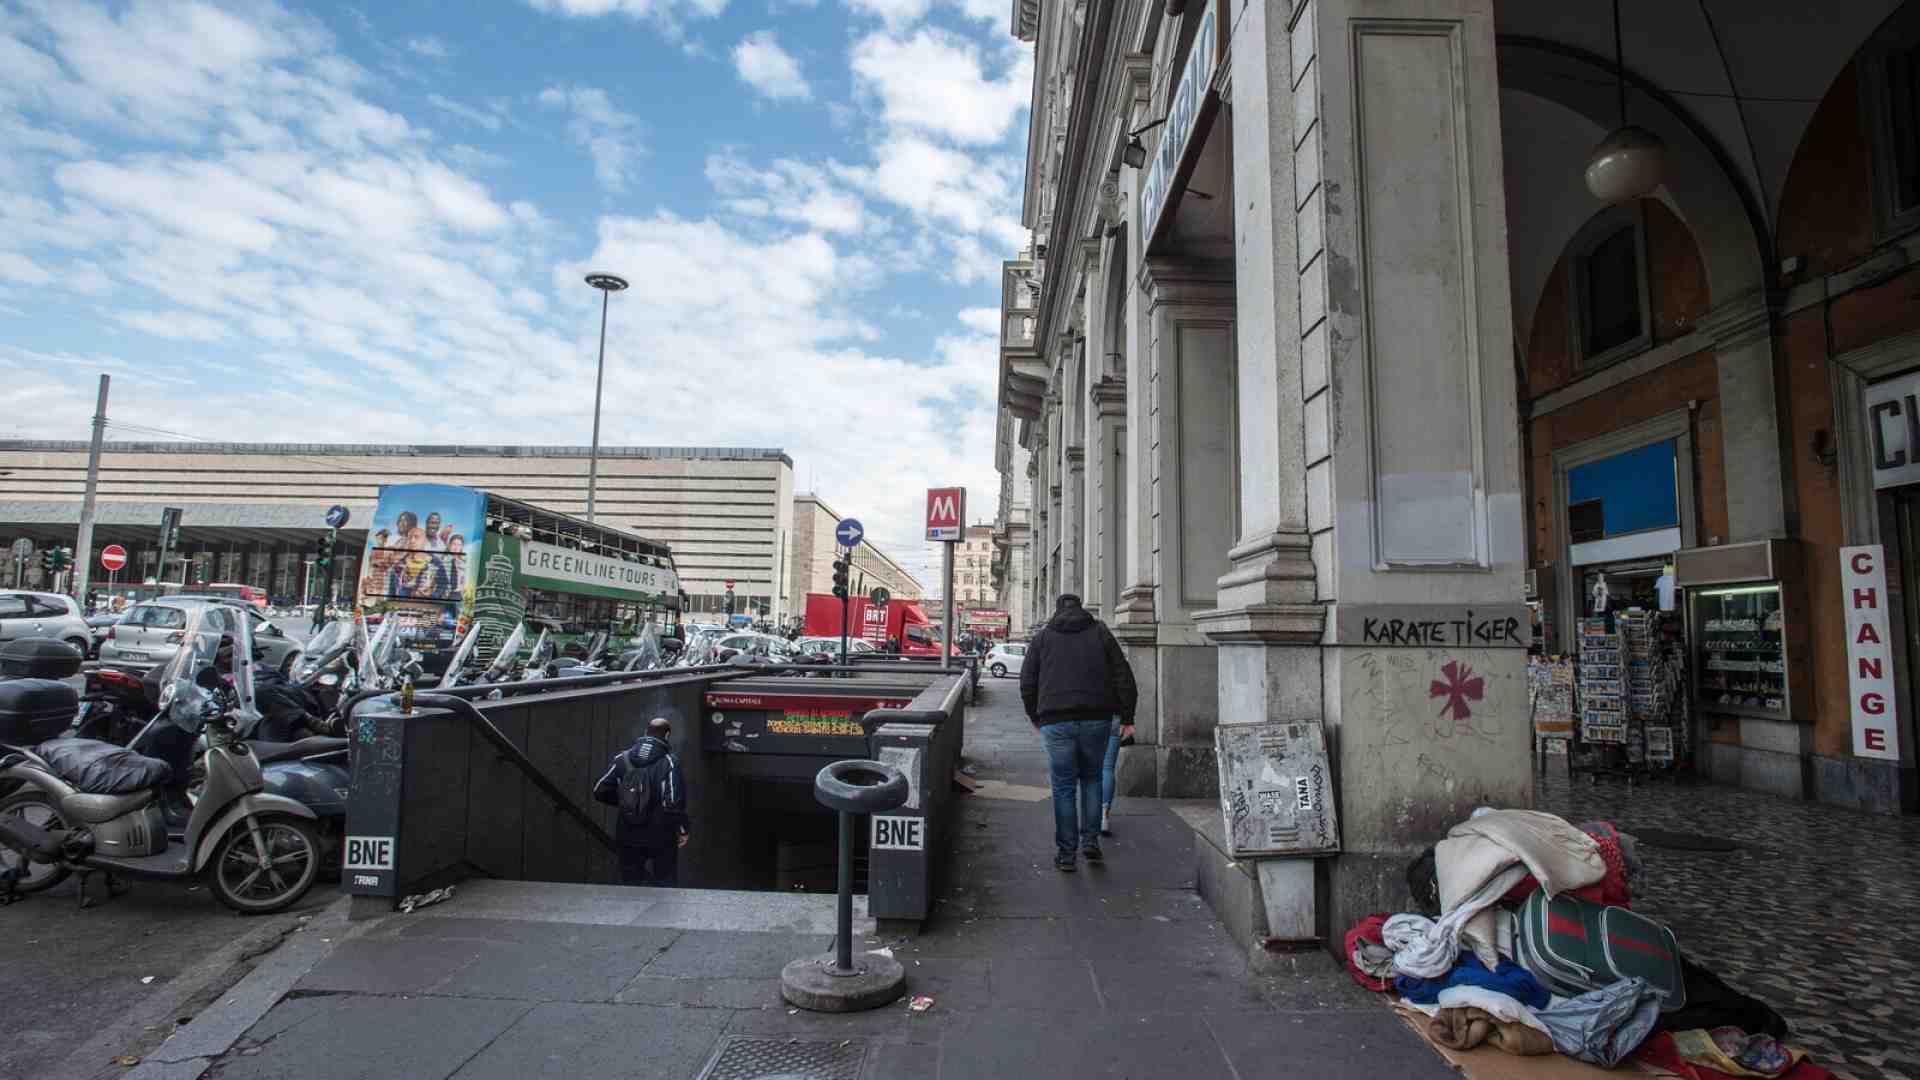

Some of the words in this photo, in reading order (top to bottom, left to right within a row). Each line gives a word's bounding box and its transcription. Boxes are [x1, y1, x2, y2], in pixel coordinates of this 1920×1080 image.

[929, 495, 956, 521] M
[527, 549, 616, 580] GREENLINE
[618, 567, 656, 587] TOURS
[865, 608, 886, 622] BRT
[1363, 616, 1446, 643] KARATE
[1850, 553, 1886, 752] CHANGE
[1297, 778, 1311, 809] TANA
[875, 819, 920, 847] BNE
[348, 839, 390, 866] BNE
